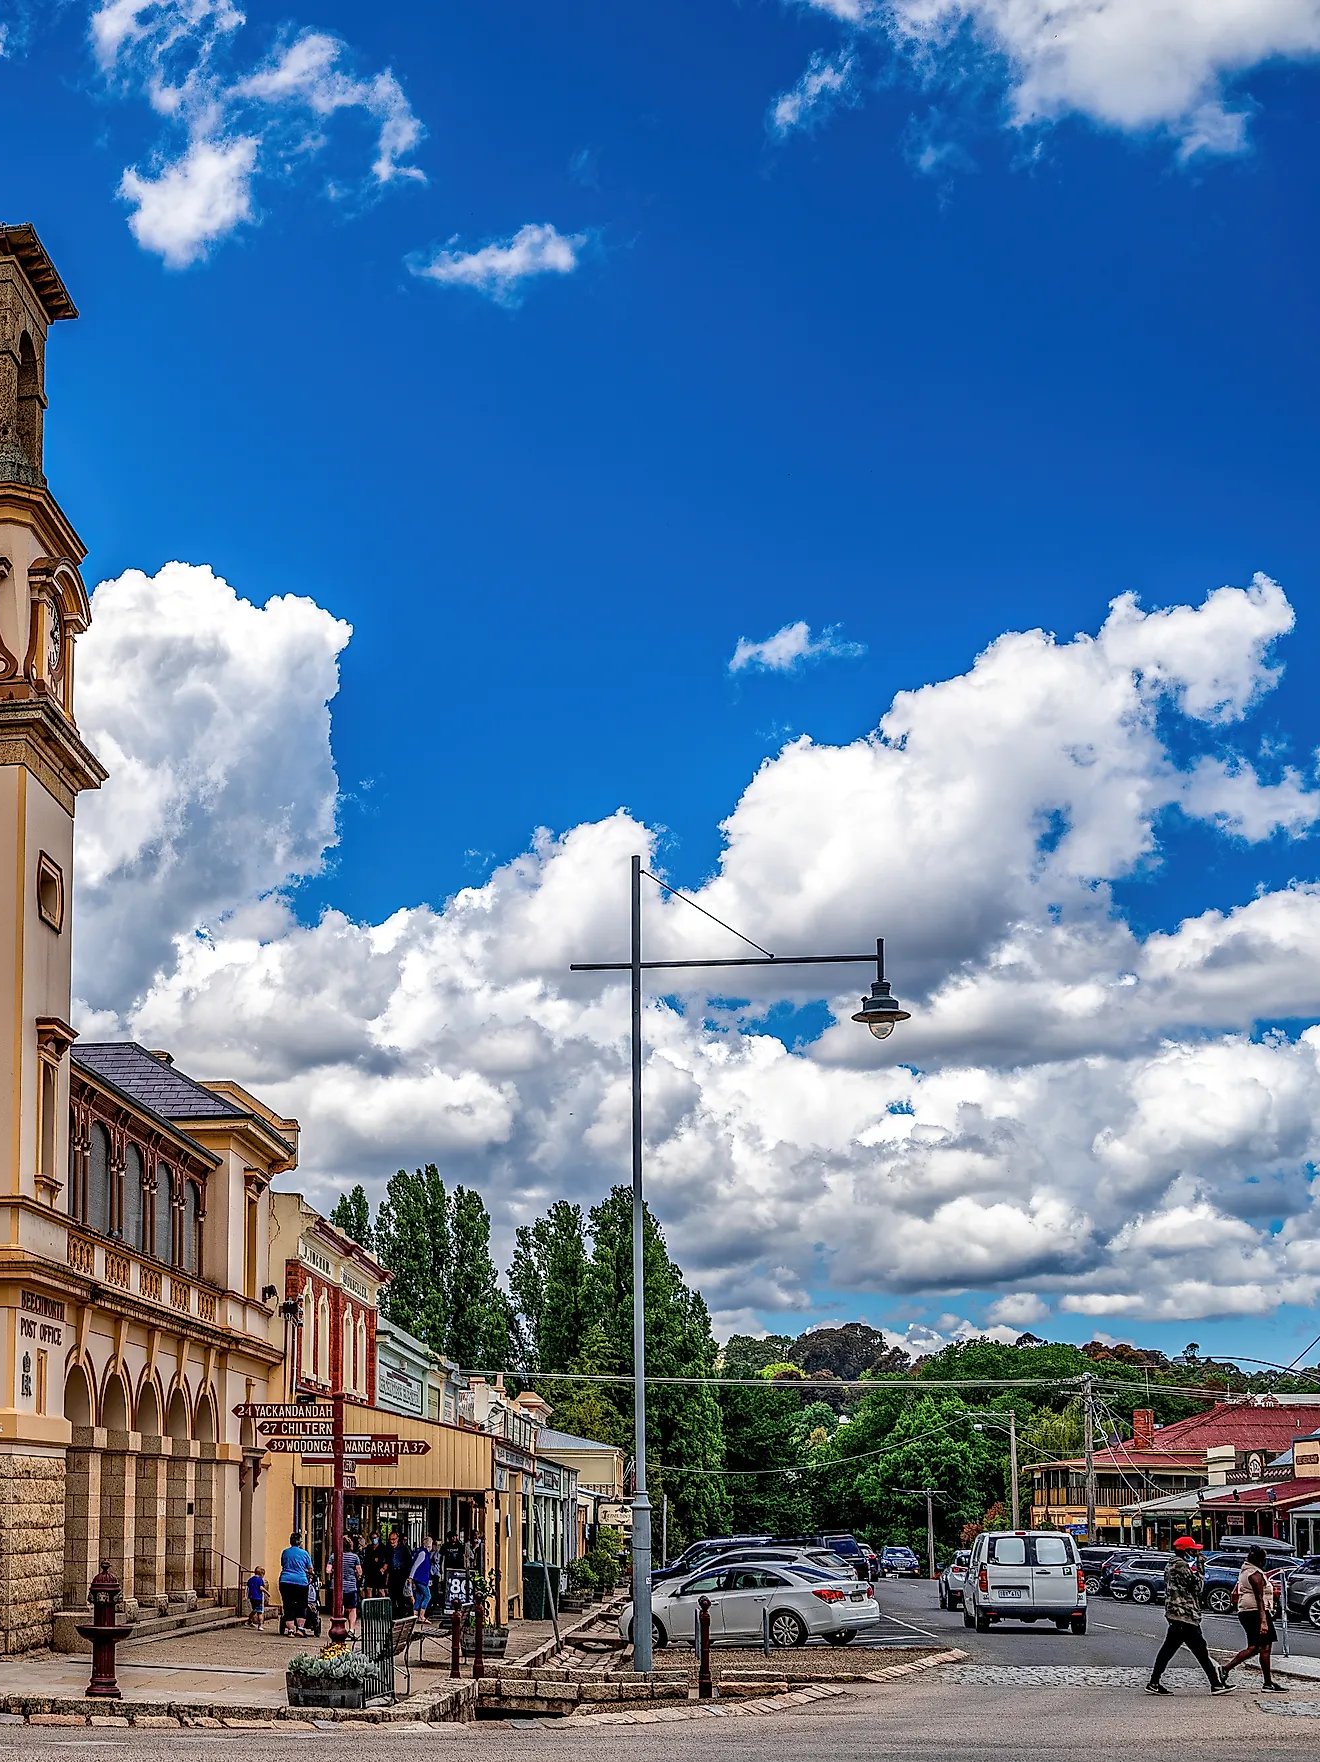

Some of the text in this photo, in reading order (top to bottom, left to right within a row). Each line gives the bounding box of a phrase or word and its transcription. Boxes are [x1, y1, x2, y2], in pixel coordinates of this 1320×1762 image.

[22, 1290, 65, 1320] BEECHWORTH
[21, 1317, 62, 1345] POST OFFICE
[237, 1405, 333, 1417] 24 YACKANDANDAH
[262, 1422, 333, 1435] 27 CHILTERN
[271, 1440, 333, 1452] 39 WODONGA
[344, 1440, 425, 1453] WANGARATTA 37
